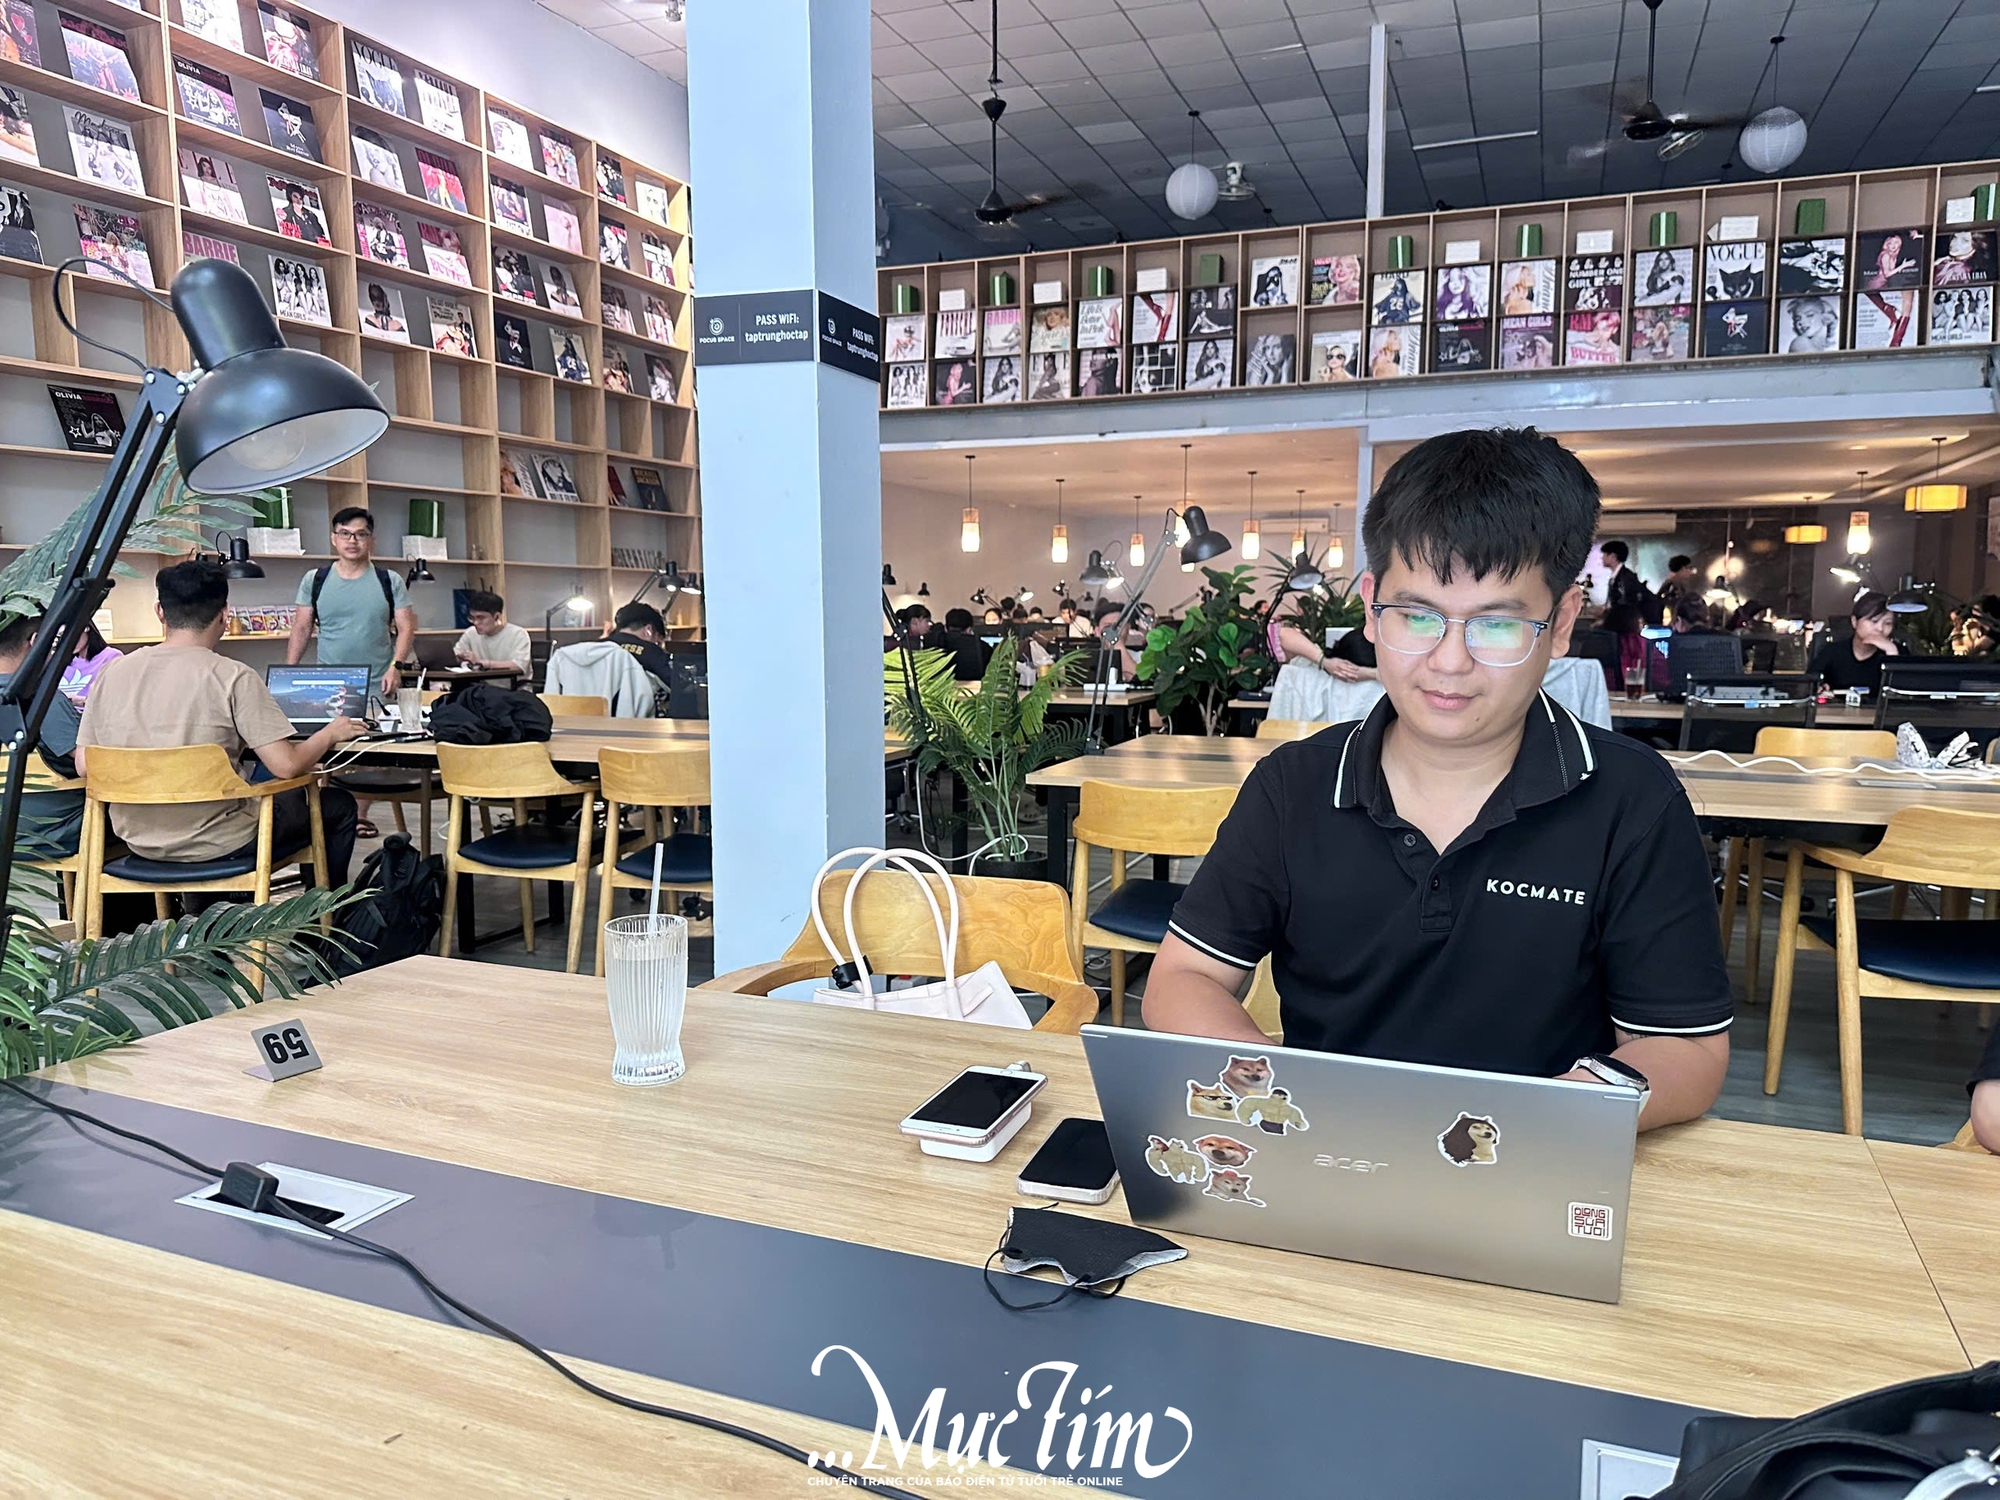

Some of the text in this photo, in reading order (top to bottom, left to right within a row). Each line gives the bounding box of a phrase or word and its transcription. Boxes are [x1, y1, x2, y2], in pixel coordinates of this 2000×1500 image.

[177, 61, 201, 75] OLIVIA
[1710, 242, 1765, 261] VOGUE
[1569, 267, 1624, 279] NUMBER ONE
[1568, 279, 1592, 289] GIRL
[755, 314, 777, 326] PASS
[699, 335, 735, 344] FOCUS SPACE
[745, 329, 808, 344] taptrunghoctap
[55, 391, 82, 400] OLIVIA
[1486, 878, 1586, 905] KOCMATE
[262, 1027, 310, 1065] 59
[1313, 1153, 1389, 1174] acer
